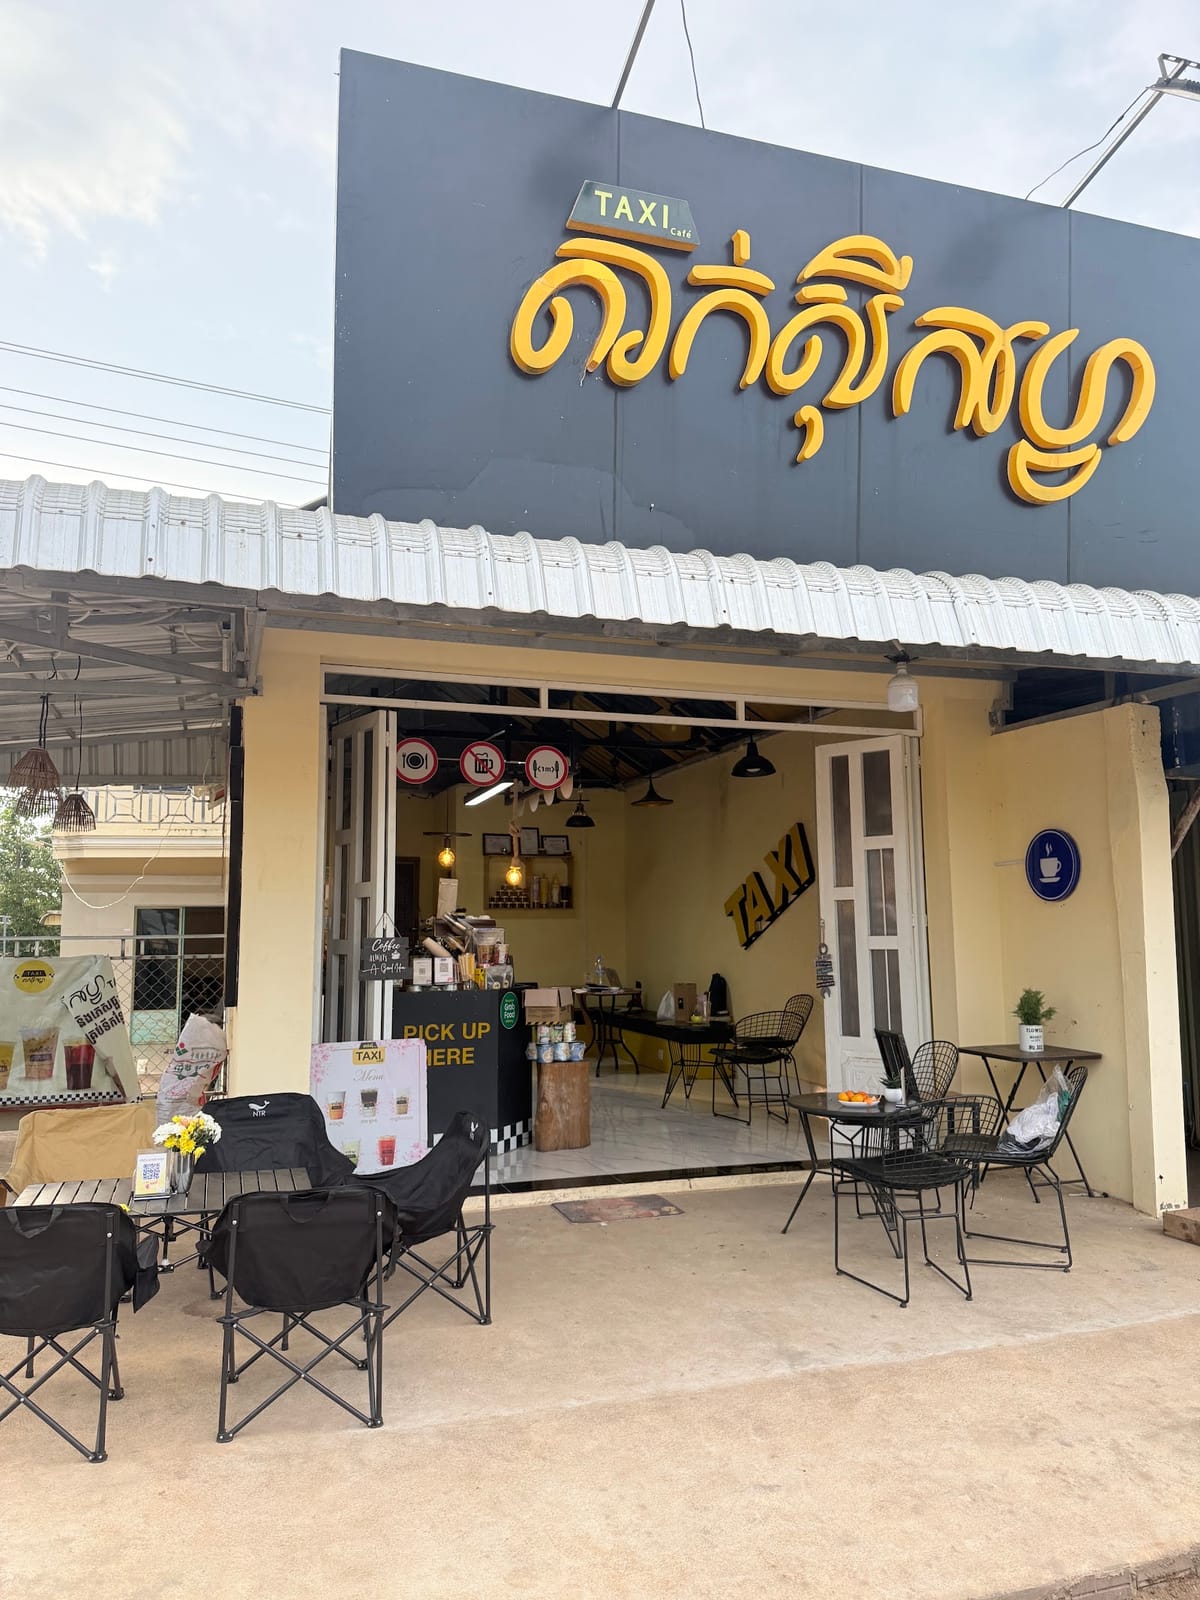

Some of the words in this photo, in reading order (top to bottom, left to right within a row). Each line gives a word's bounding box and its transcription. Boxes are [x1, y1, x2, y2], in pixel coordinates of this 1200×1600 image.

[594, 189, 669, 229] TAXI
[670, 227, 692, 239] Café
[724, 822, 816, 950] TAXI
[371, 938, 401, 952] Coffee
[504, 1002, 515, 1011] Grab
[504, 1010, 515, 1019] Food
[403, 1023, 455, 1041] PICK
[462, 1022, 491, 1040] UP
[356, 1051, 381, 1061] TAXI
